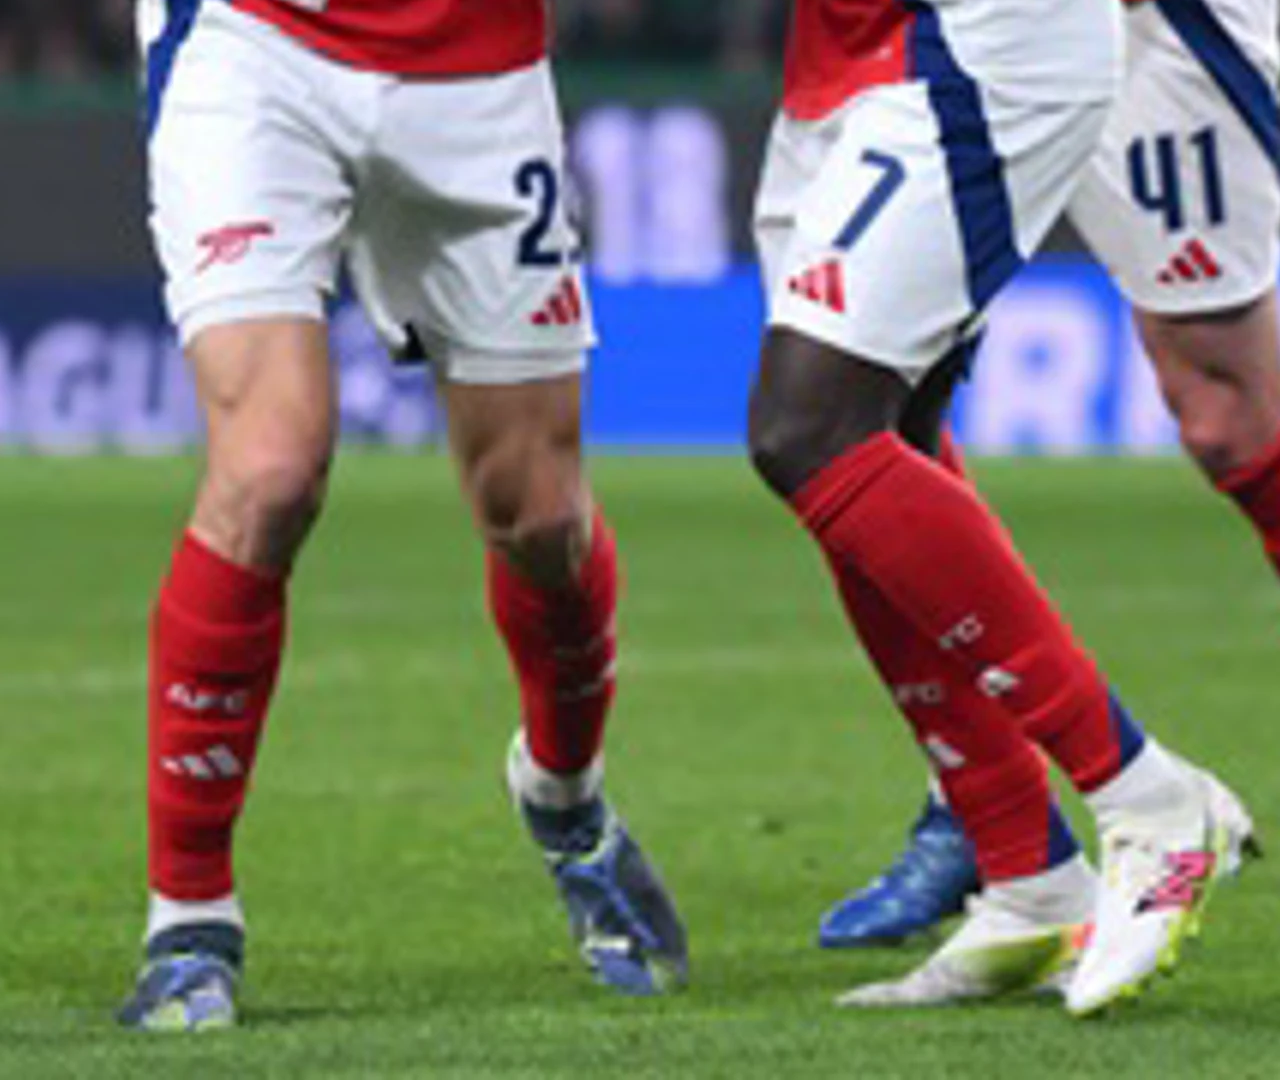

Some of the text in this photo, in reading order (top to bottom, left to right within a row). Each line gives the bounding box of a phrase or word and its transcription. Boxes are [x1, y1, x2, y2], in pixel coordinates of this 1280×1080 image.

[513, 157, 582, 266] 2
[831, 147, 910, 252] 7
[1126, 125, 1227, 233] 41
